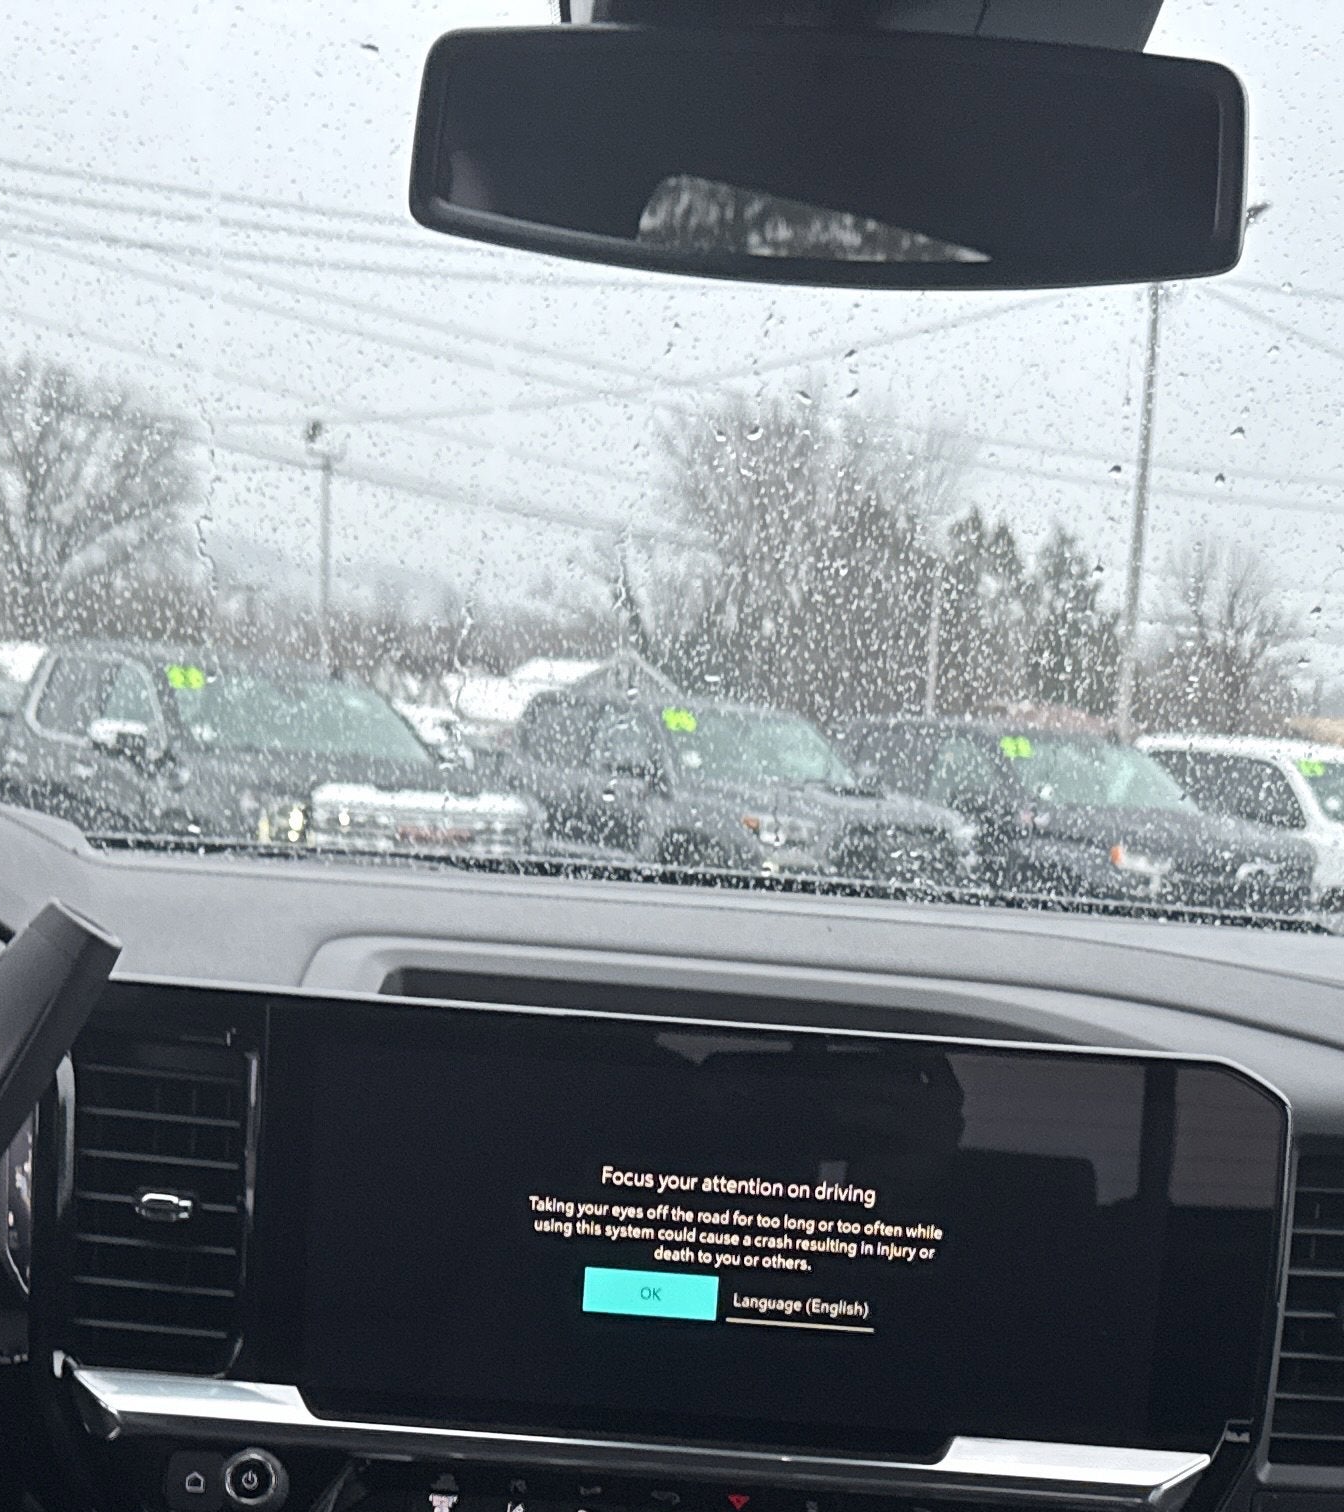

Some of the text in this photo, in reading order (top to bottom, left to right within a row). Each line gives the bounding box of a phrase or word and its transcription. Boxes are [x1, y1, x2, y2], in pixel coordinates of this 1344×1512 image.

[601, 1165, 876, 1209] Focus your attention on driving
[529, 1195, 943, 1241] Taking your eyes off the road for too long or too often while
[534, 1218, 936, 1262] using this system could cause a crash resulting in injury or
[654, 1245, 812, 1272] death to you or others.
[640, 1286, 662, 1302] OK
[733, 1292, 870, 1319] Language (English)
